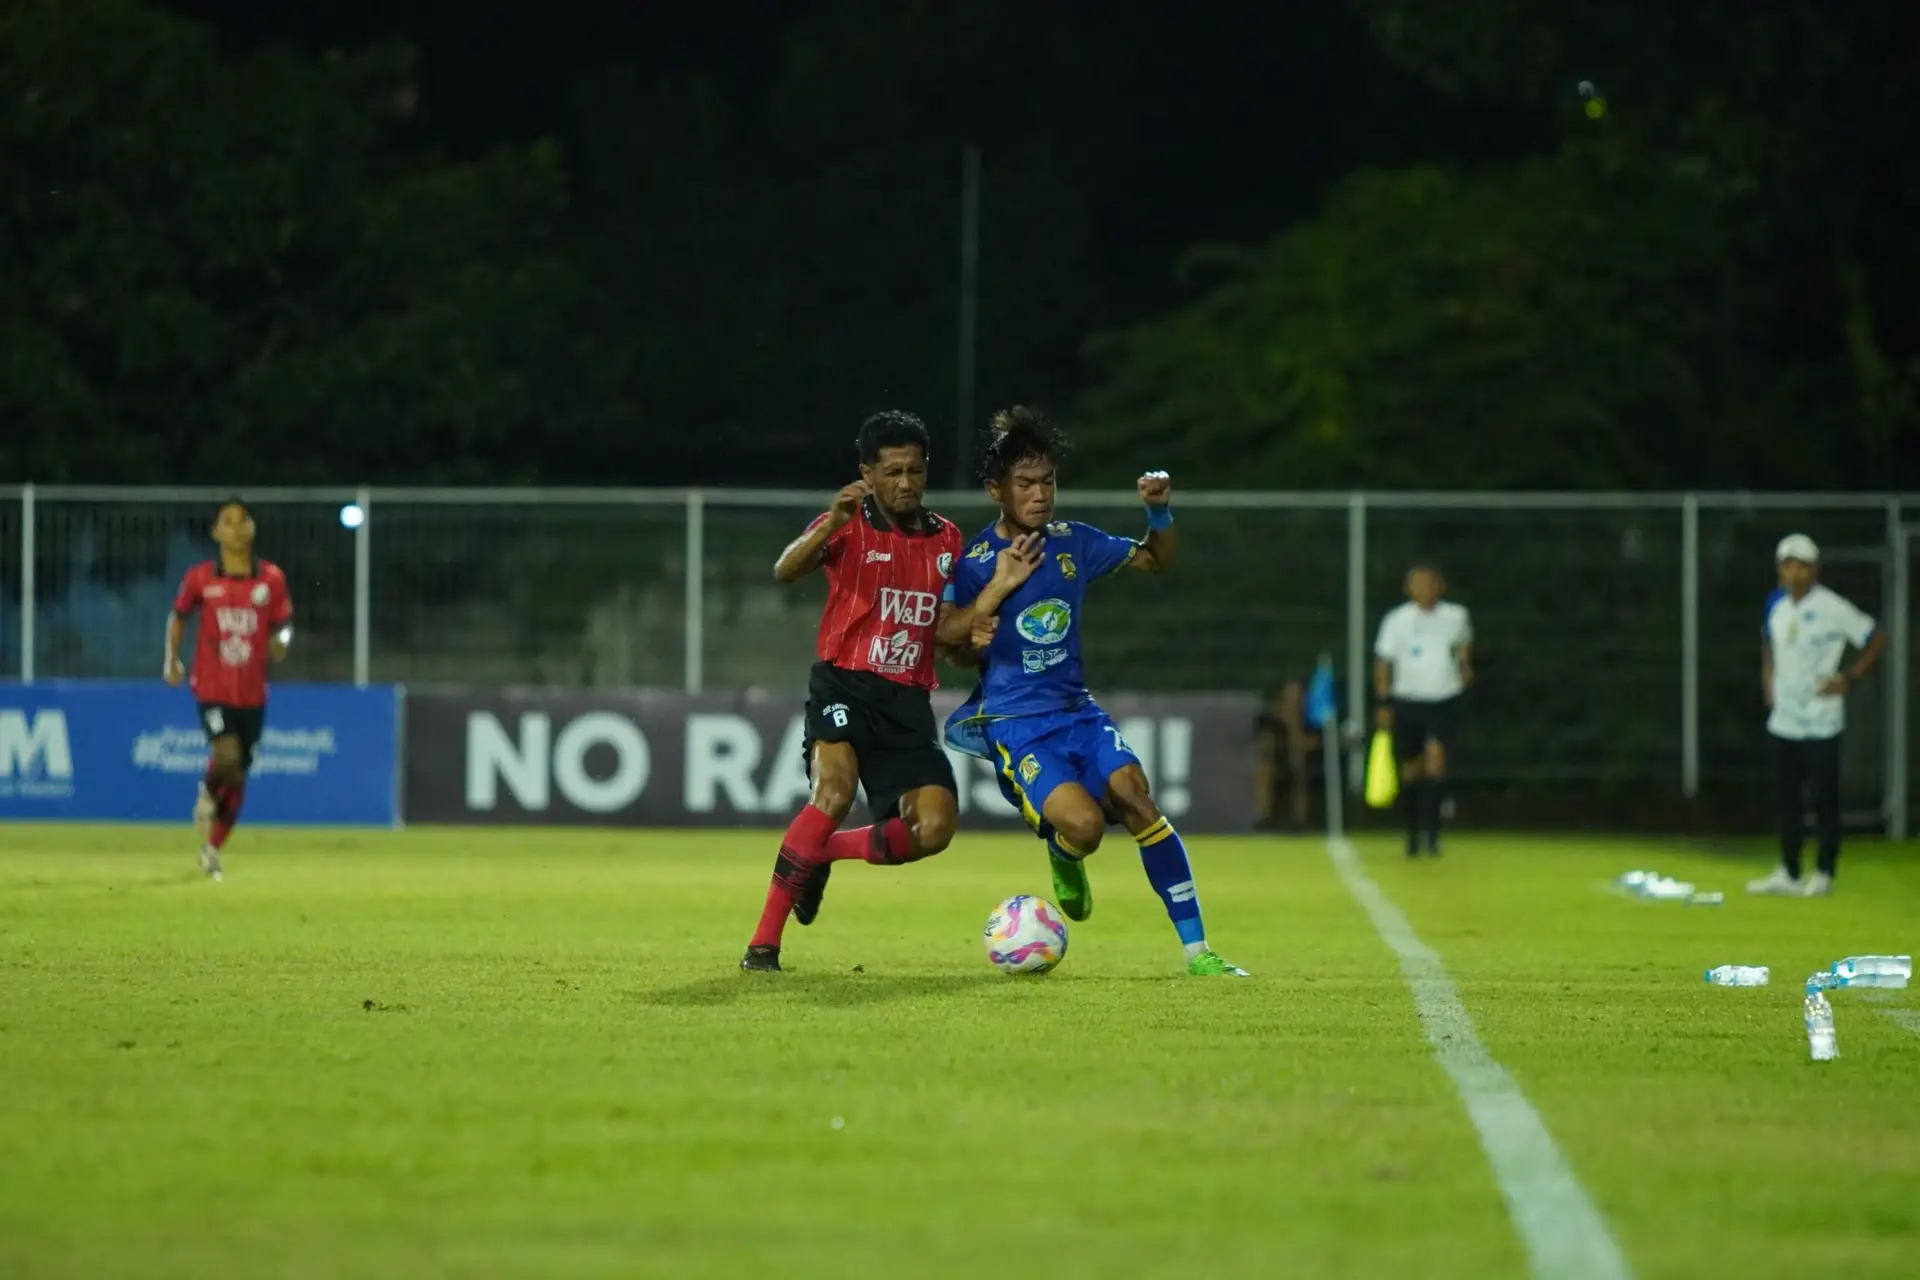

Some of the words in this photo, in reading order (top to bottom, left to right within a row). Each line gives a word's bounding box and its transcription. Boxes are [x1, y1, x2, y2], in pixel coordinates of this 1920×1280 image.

[880, 587, 938, 627] W&B
[870, 638, 920, 667] NZR
[877, 666, 906, 674] GROUP
[832, 708, 848, 728] 8
[465, 711, 652, 813] NO
[684, 712, 1192, 815] RAIS!
